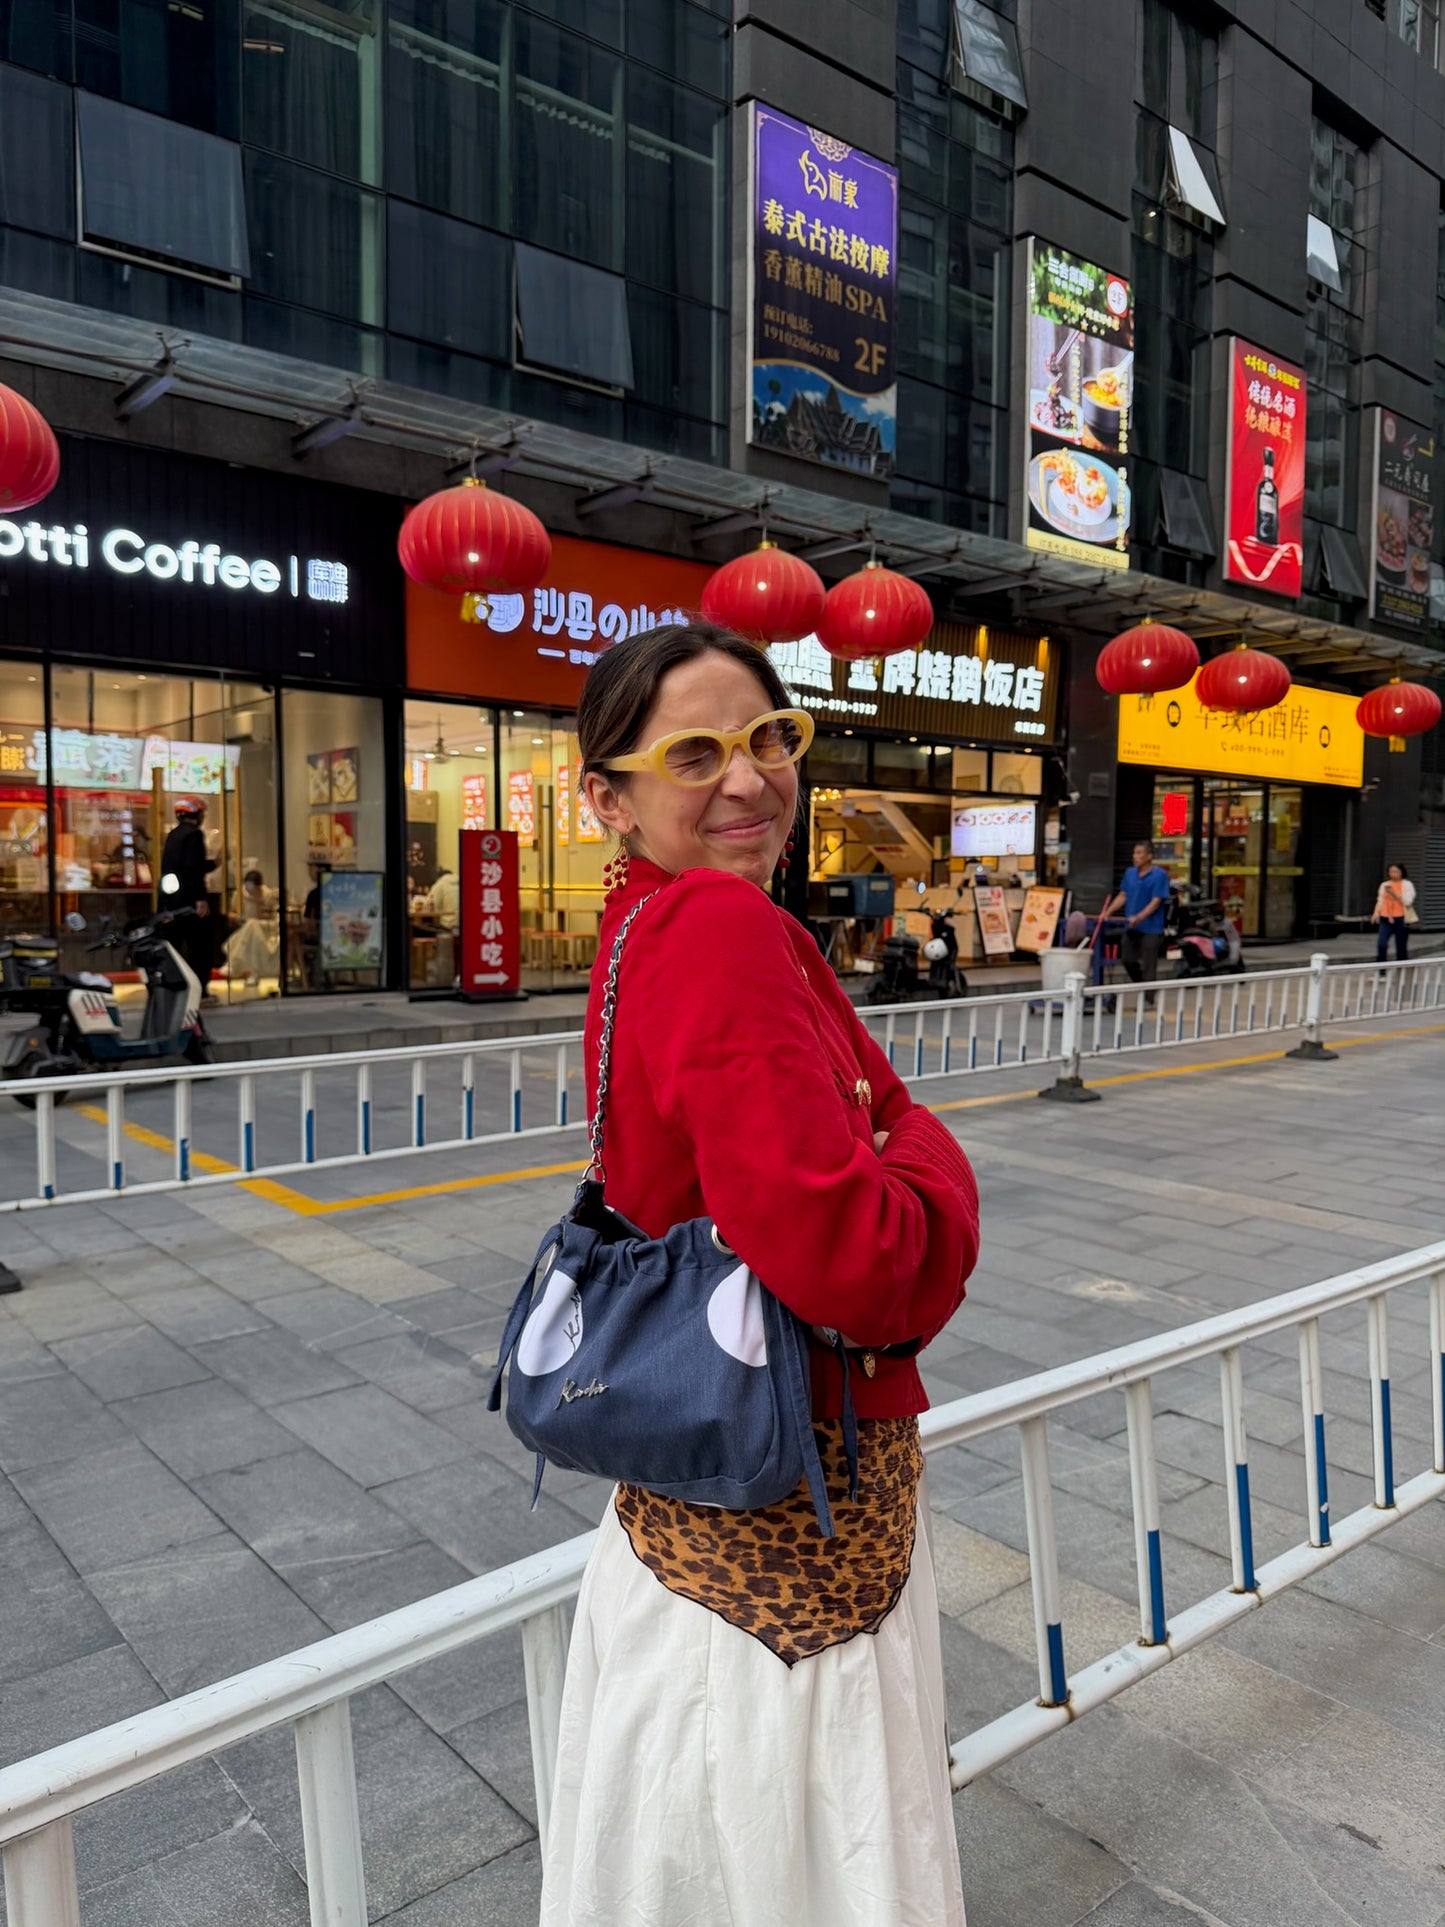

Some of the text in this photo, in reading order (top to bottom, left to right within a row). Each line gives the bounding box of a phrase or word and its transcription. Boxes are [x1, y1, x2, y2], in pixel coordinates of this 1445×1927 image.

[763, 198, 889, 279] 泰式古法按摩
[854, 337, 888, 375] 2F
[102, 528, 281, 593] Coffee
[481, 862, 503, 966] 沙县小吃
